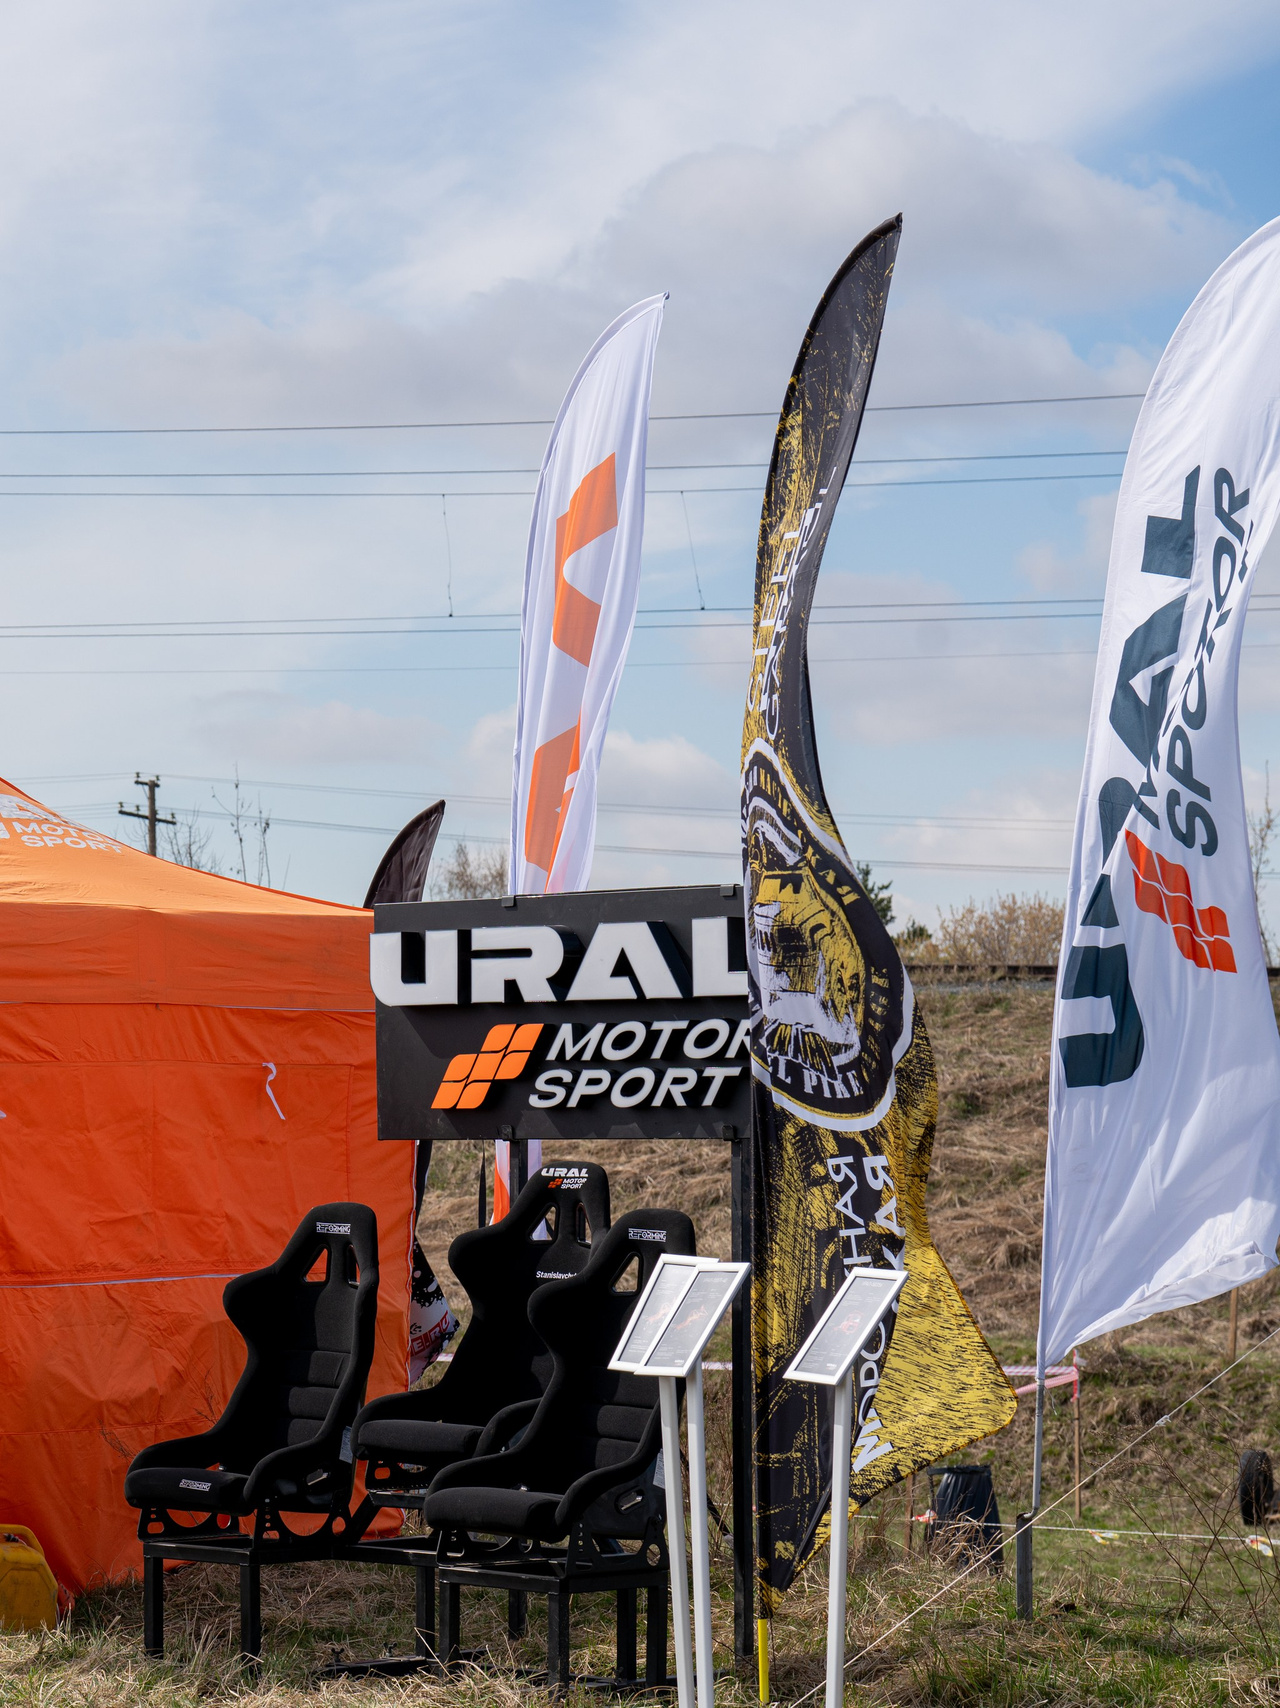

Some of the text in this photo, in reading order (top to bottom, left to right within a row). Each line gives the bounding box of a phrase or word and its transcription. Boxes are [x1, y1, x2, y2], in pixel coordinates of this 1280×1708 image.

[20, 835, 123, 854] SPORT
[370, 915, 749, 1007] URAL
[528, 1066, 743, 1110] SPORT
[541, 1167, 589, 1178] URAL
[628, 1228, 667, 1242] REFORMING
